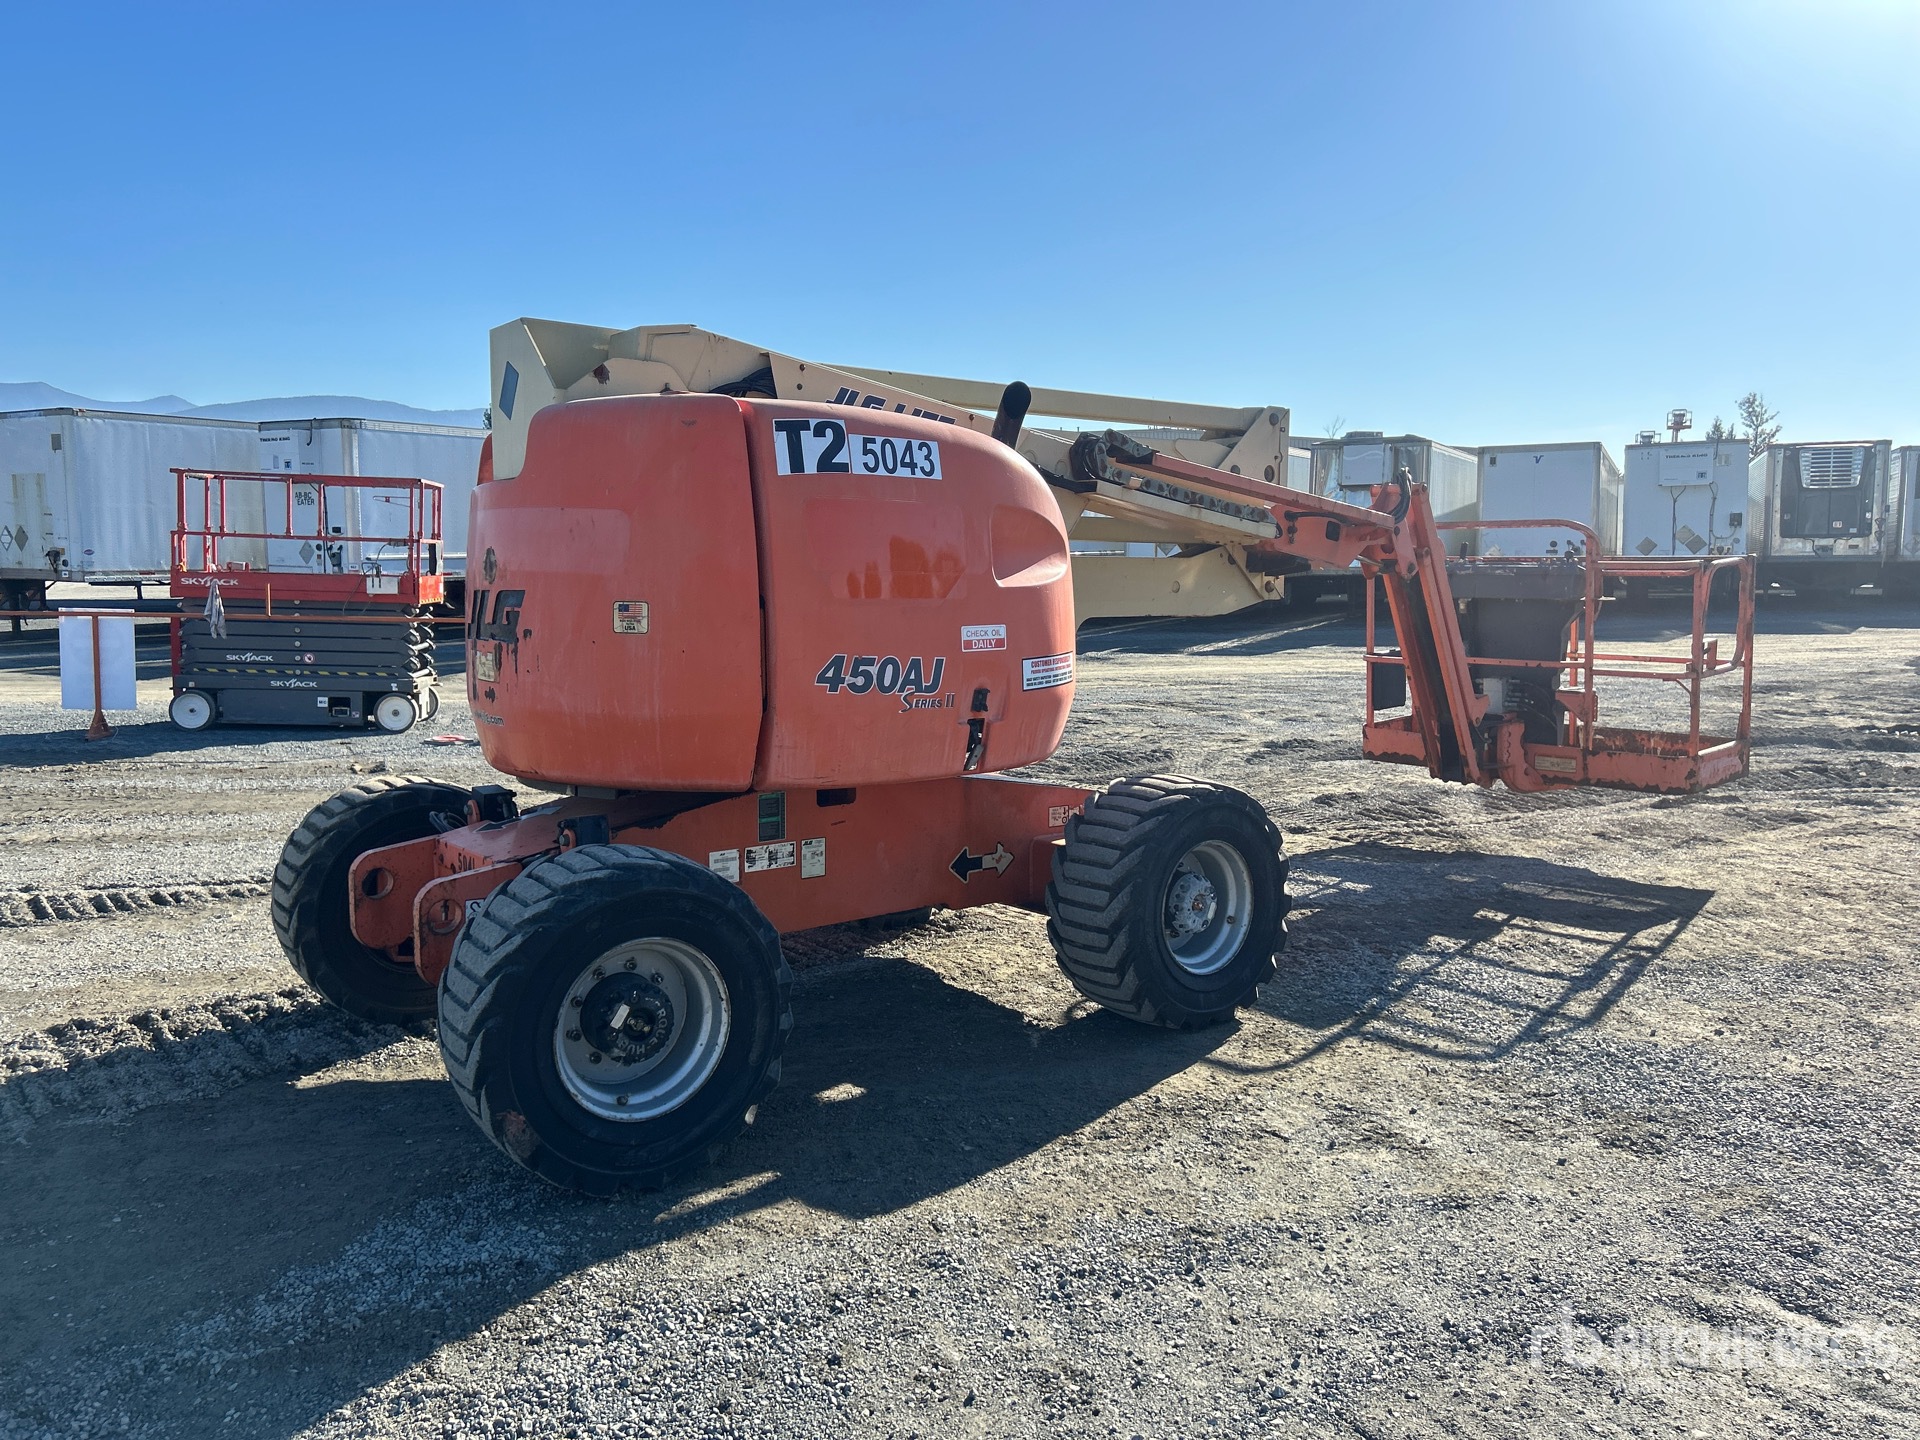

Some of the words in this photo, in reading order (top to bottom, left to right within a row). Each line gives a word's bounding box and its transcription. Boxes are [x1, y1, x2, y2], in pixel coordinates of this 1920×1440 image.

[774, 420, 849, 473] T2
[862, 436, 935, 477] 5043
[180, 575, 239, 587] SKYJACK
[467, 589, 526, 643] JLG
[966, 629, 989, 638] CHECK
[991, 628, 1002, 637] OIL
[972, 639, 996, 649] DAILY
[225, 652, 274, 662] SKYJACK
[815, 654, 946, 695] 450AJ
[270, 678, 318, 689] SKYJACK
[944, 692, 956, 709] II
